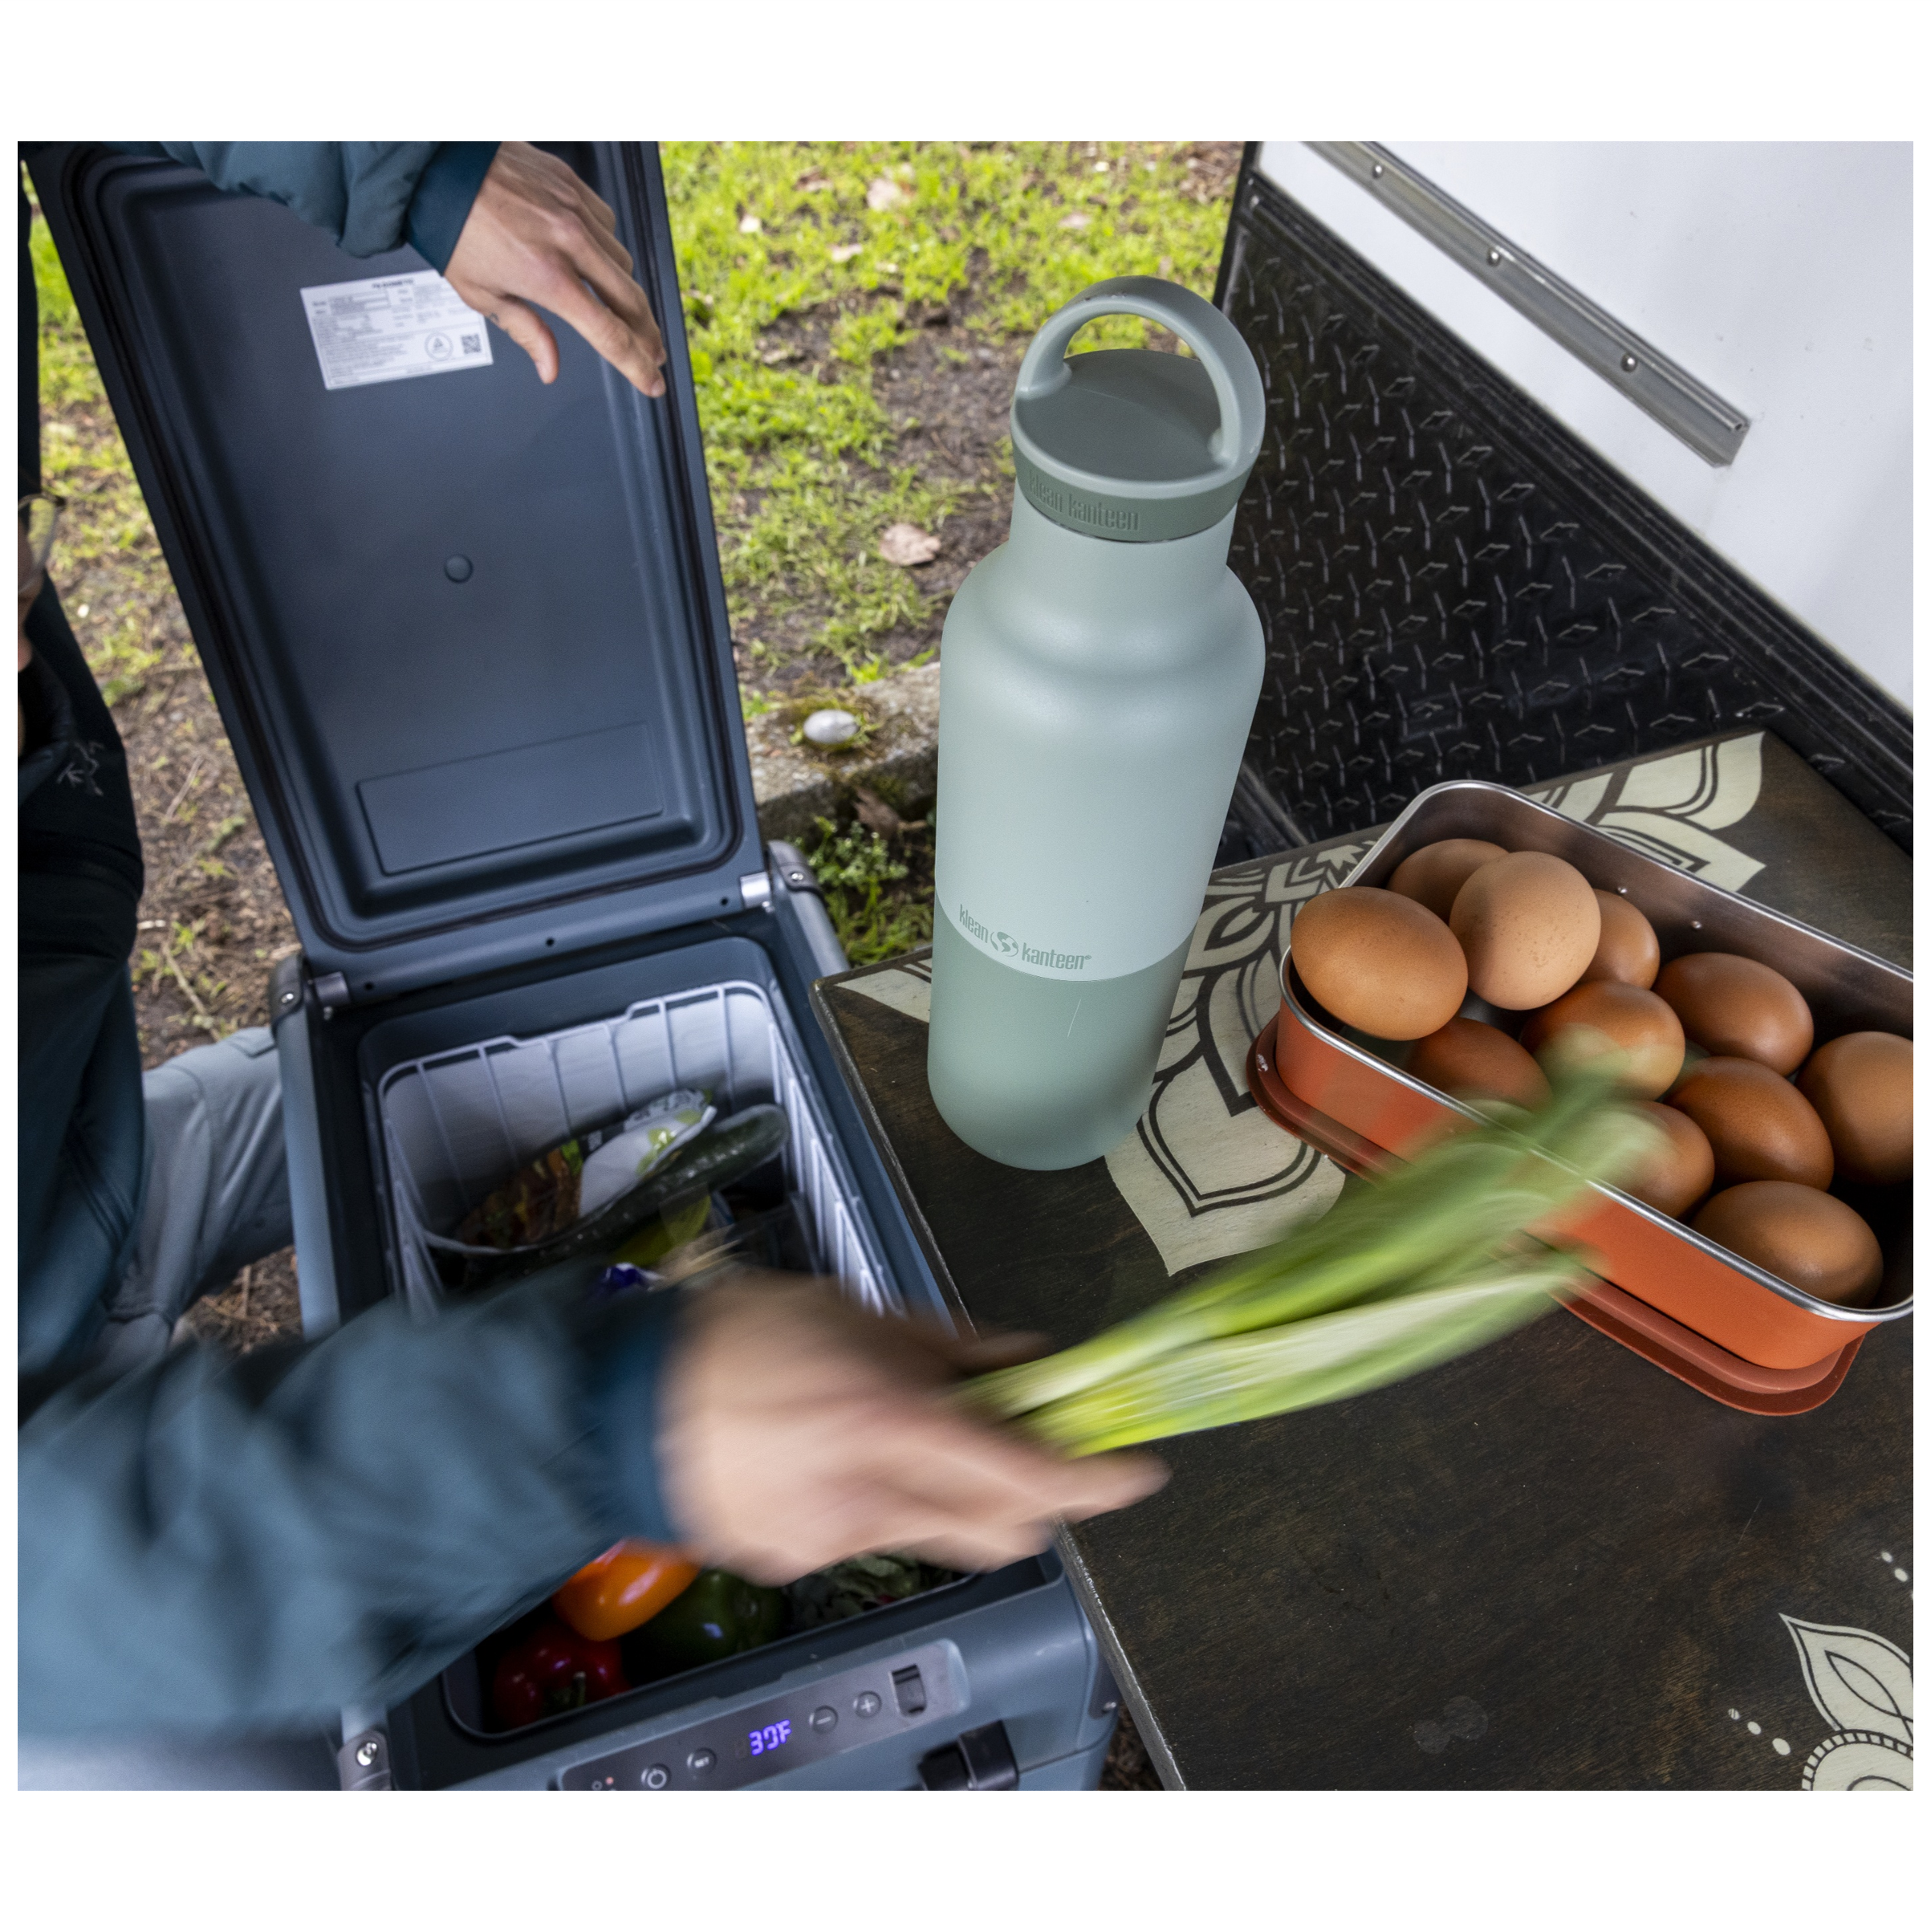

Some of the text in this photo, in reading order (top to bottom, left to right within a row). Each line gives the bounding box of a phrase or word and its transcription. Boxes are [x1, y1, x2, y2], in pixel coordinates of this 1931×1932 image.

[1029, 470, 1140, 531] klean kanteen
[959, 903, 988, 943] klean
